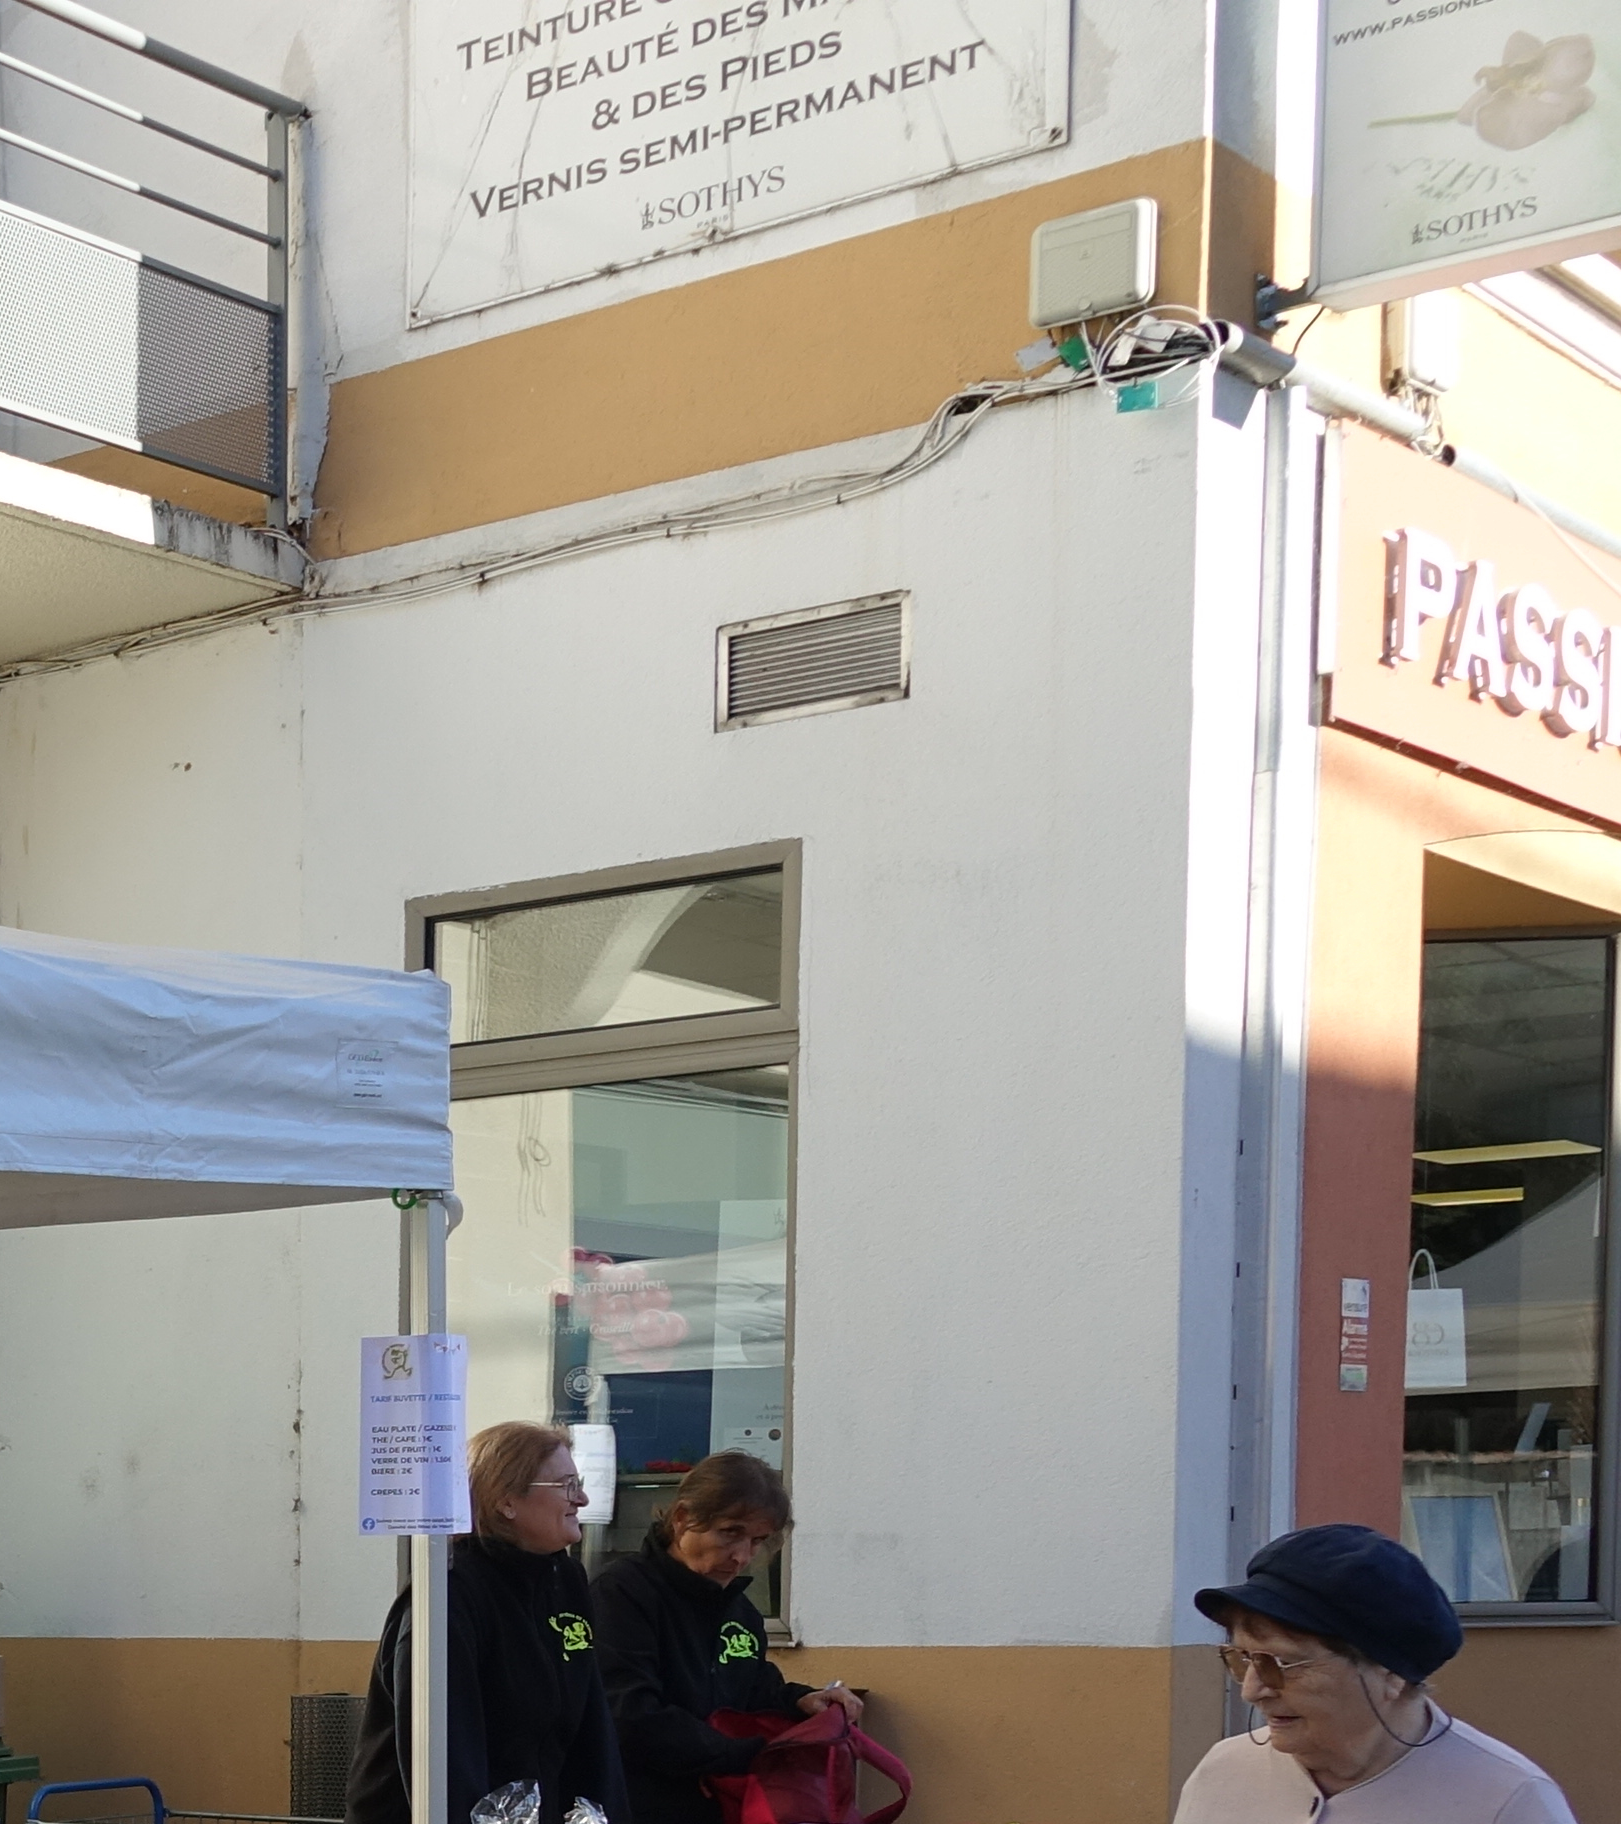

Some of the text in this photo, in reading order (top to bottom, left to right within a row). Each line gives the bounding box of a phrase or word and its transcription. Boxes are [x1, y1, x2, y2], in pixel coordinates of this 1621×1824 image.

[457, 0, 642, 71] TEINTURE
[525, 0, 768, 101] BEAUTÉ DES
[591, 30, 843, 130] & DES PIEDS
[469, 38, 985, 220] VERNIS SEMI-PERMANENT
[657, 165, 786, 225] SOTHYS
[1426, 196, 1539, 241] SOTHYS
